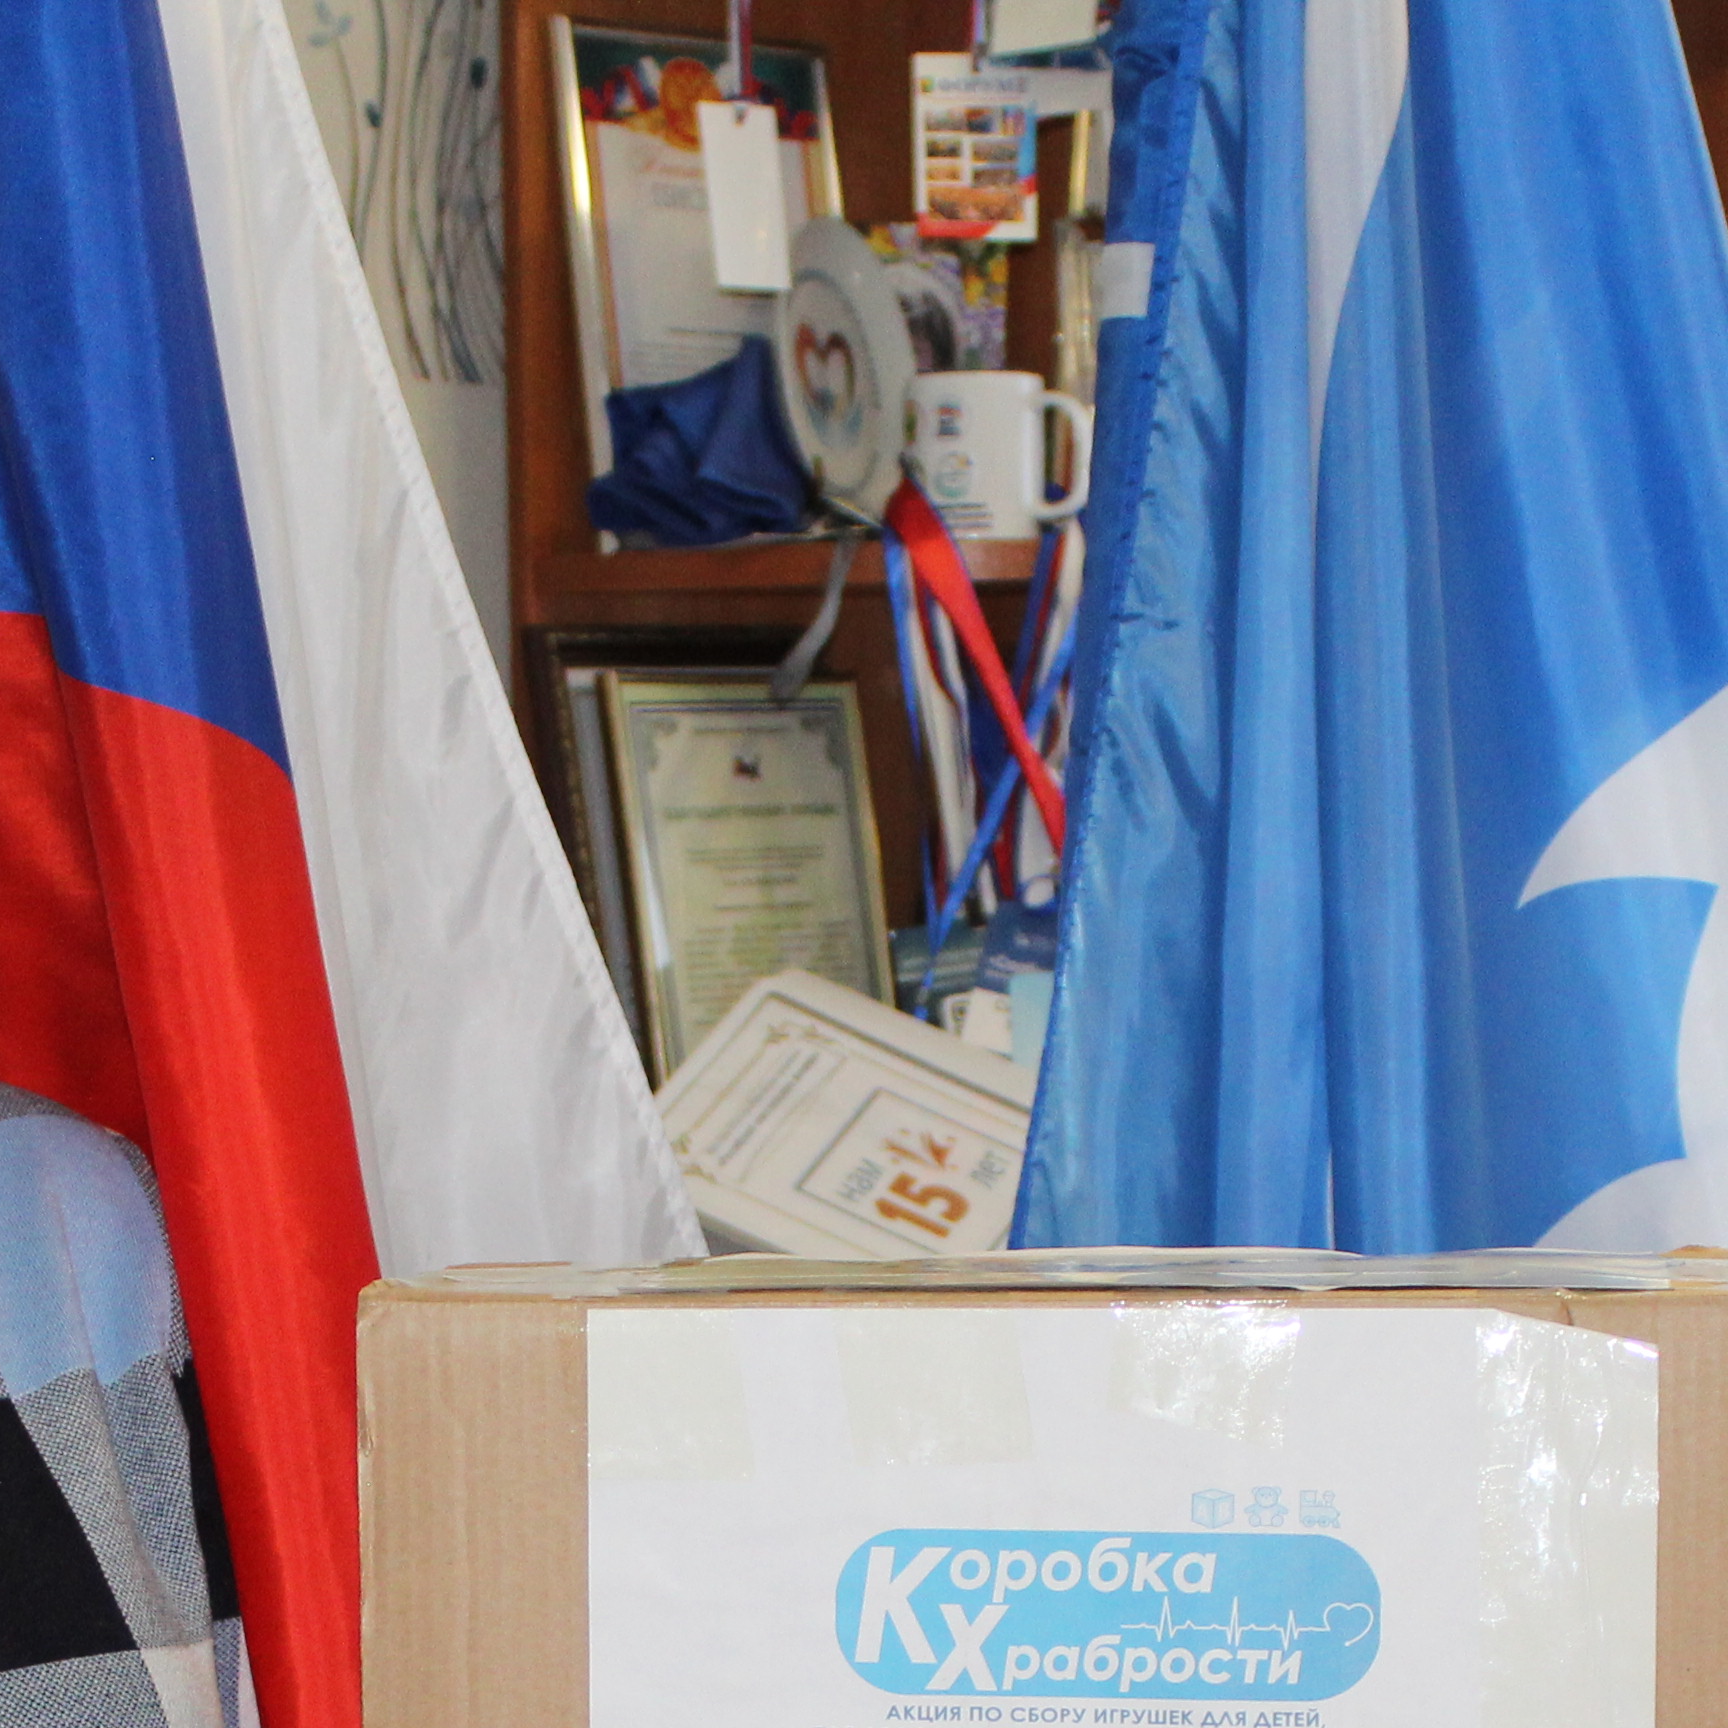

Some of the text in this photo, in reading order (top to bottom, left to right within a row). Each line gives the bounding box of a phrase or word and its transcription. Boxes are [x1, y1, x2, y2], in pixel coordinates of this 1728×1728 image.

[875, 1171, 969, 1239] 15
[854, 1537, 1217, 1665] Коробка
[925, 1604, 1303, 1693] Храбрости
[886, 1705, 962, 1724] АКЦИЯ
[969, 1706, 1002, 1724] ПО
[1005, 1707, 1087, 1725] СБОРУ
[1094, 1708, 1194, 1726] ИГРУШЕК
[1200, 1710, 1247, 1728] ДЛЯ
